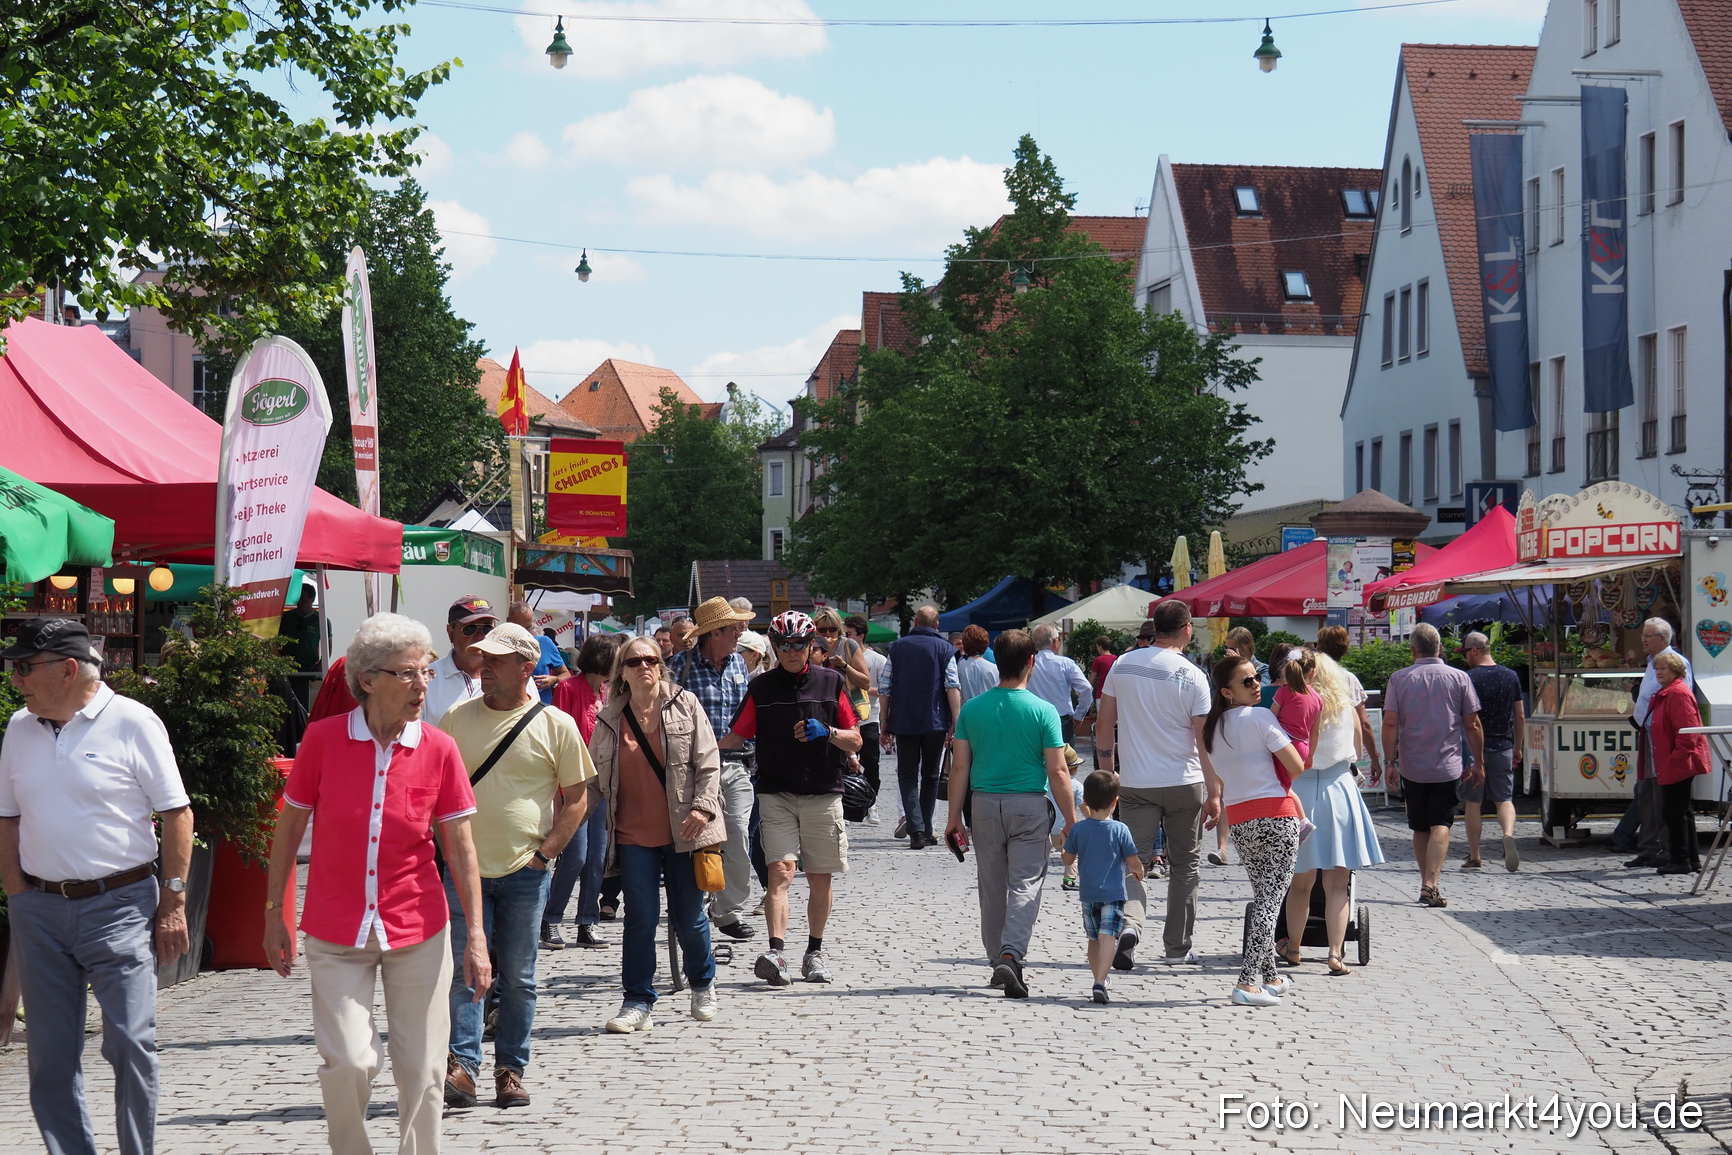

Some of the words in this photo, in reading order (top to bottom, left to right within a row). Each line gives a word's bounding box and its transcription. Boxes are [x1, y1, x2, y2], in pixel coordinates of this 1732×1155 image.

[1484, 236, 1521, 324] K&L
[552, 465, 568, 477] stet's
[569, 457, 589, 472] frische
[554, 457, 619, 491] CHURROS
[256, 501, 286, 517] Theke
[1548, 524, 1678, 557] POPCORN
[1386, 588, 1441, 608] MAGENBROT
